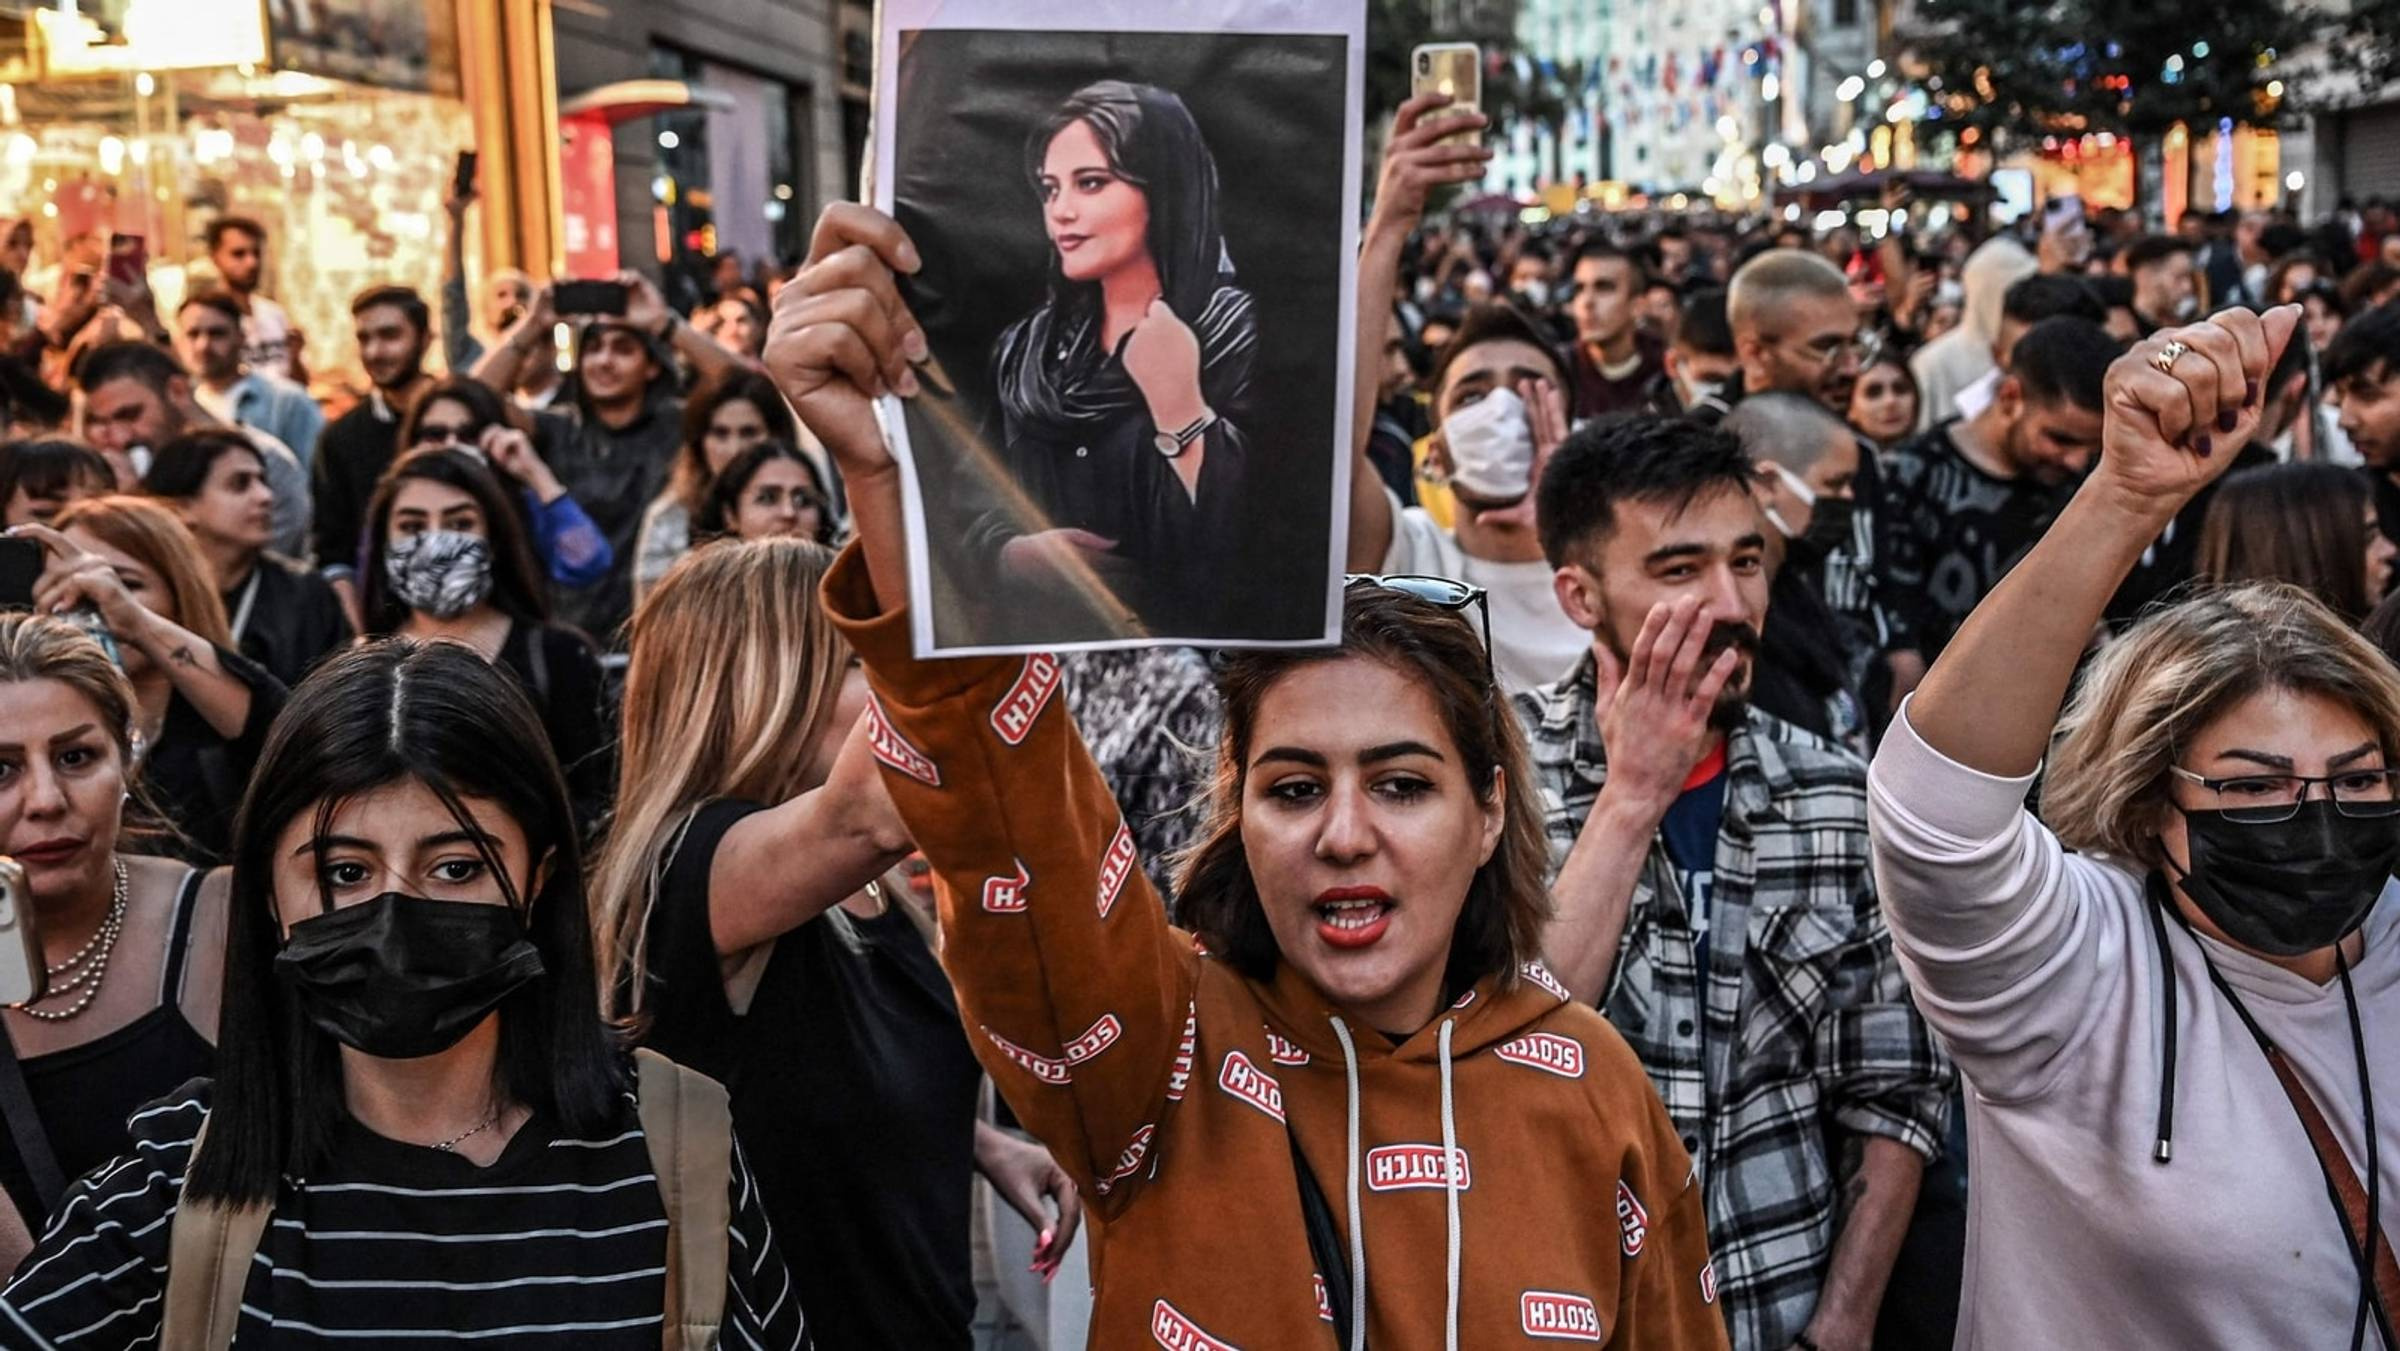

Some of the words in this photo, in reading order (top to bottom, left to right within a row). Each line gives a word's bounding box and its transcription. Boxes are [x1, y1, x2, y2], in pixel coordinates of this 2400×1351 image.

[1003, 653, 1058, 733] OTCH
[1228, 1062, 1282, 1112] OTCH
[1530, 1302, 1597, 1332] SCOTCH
